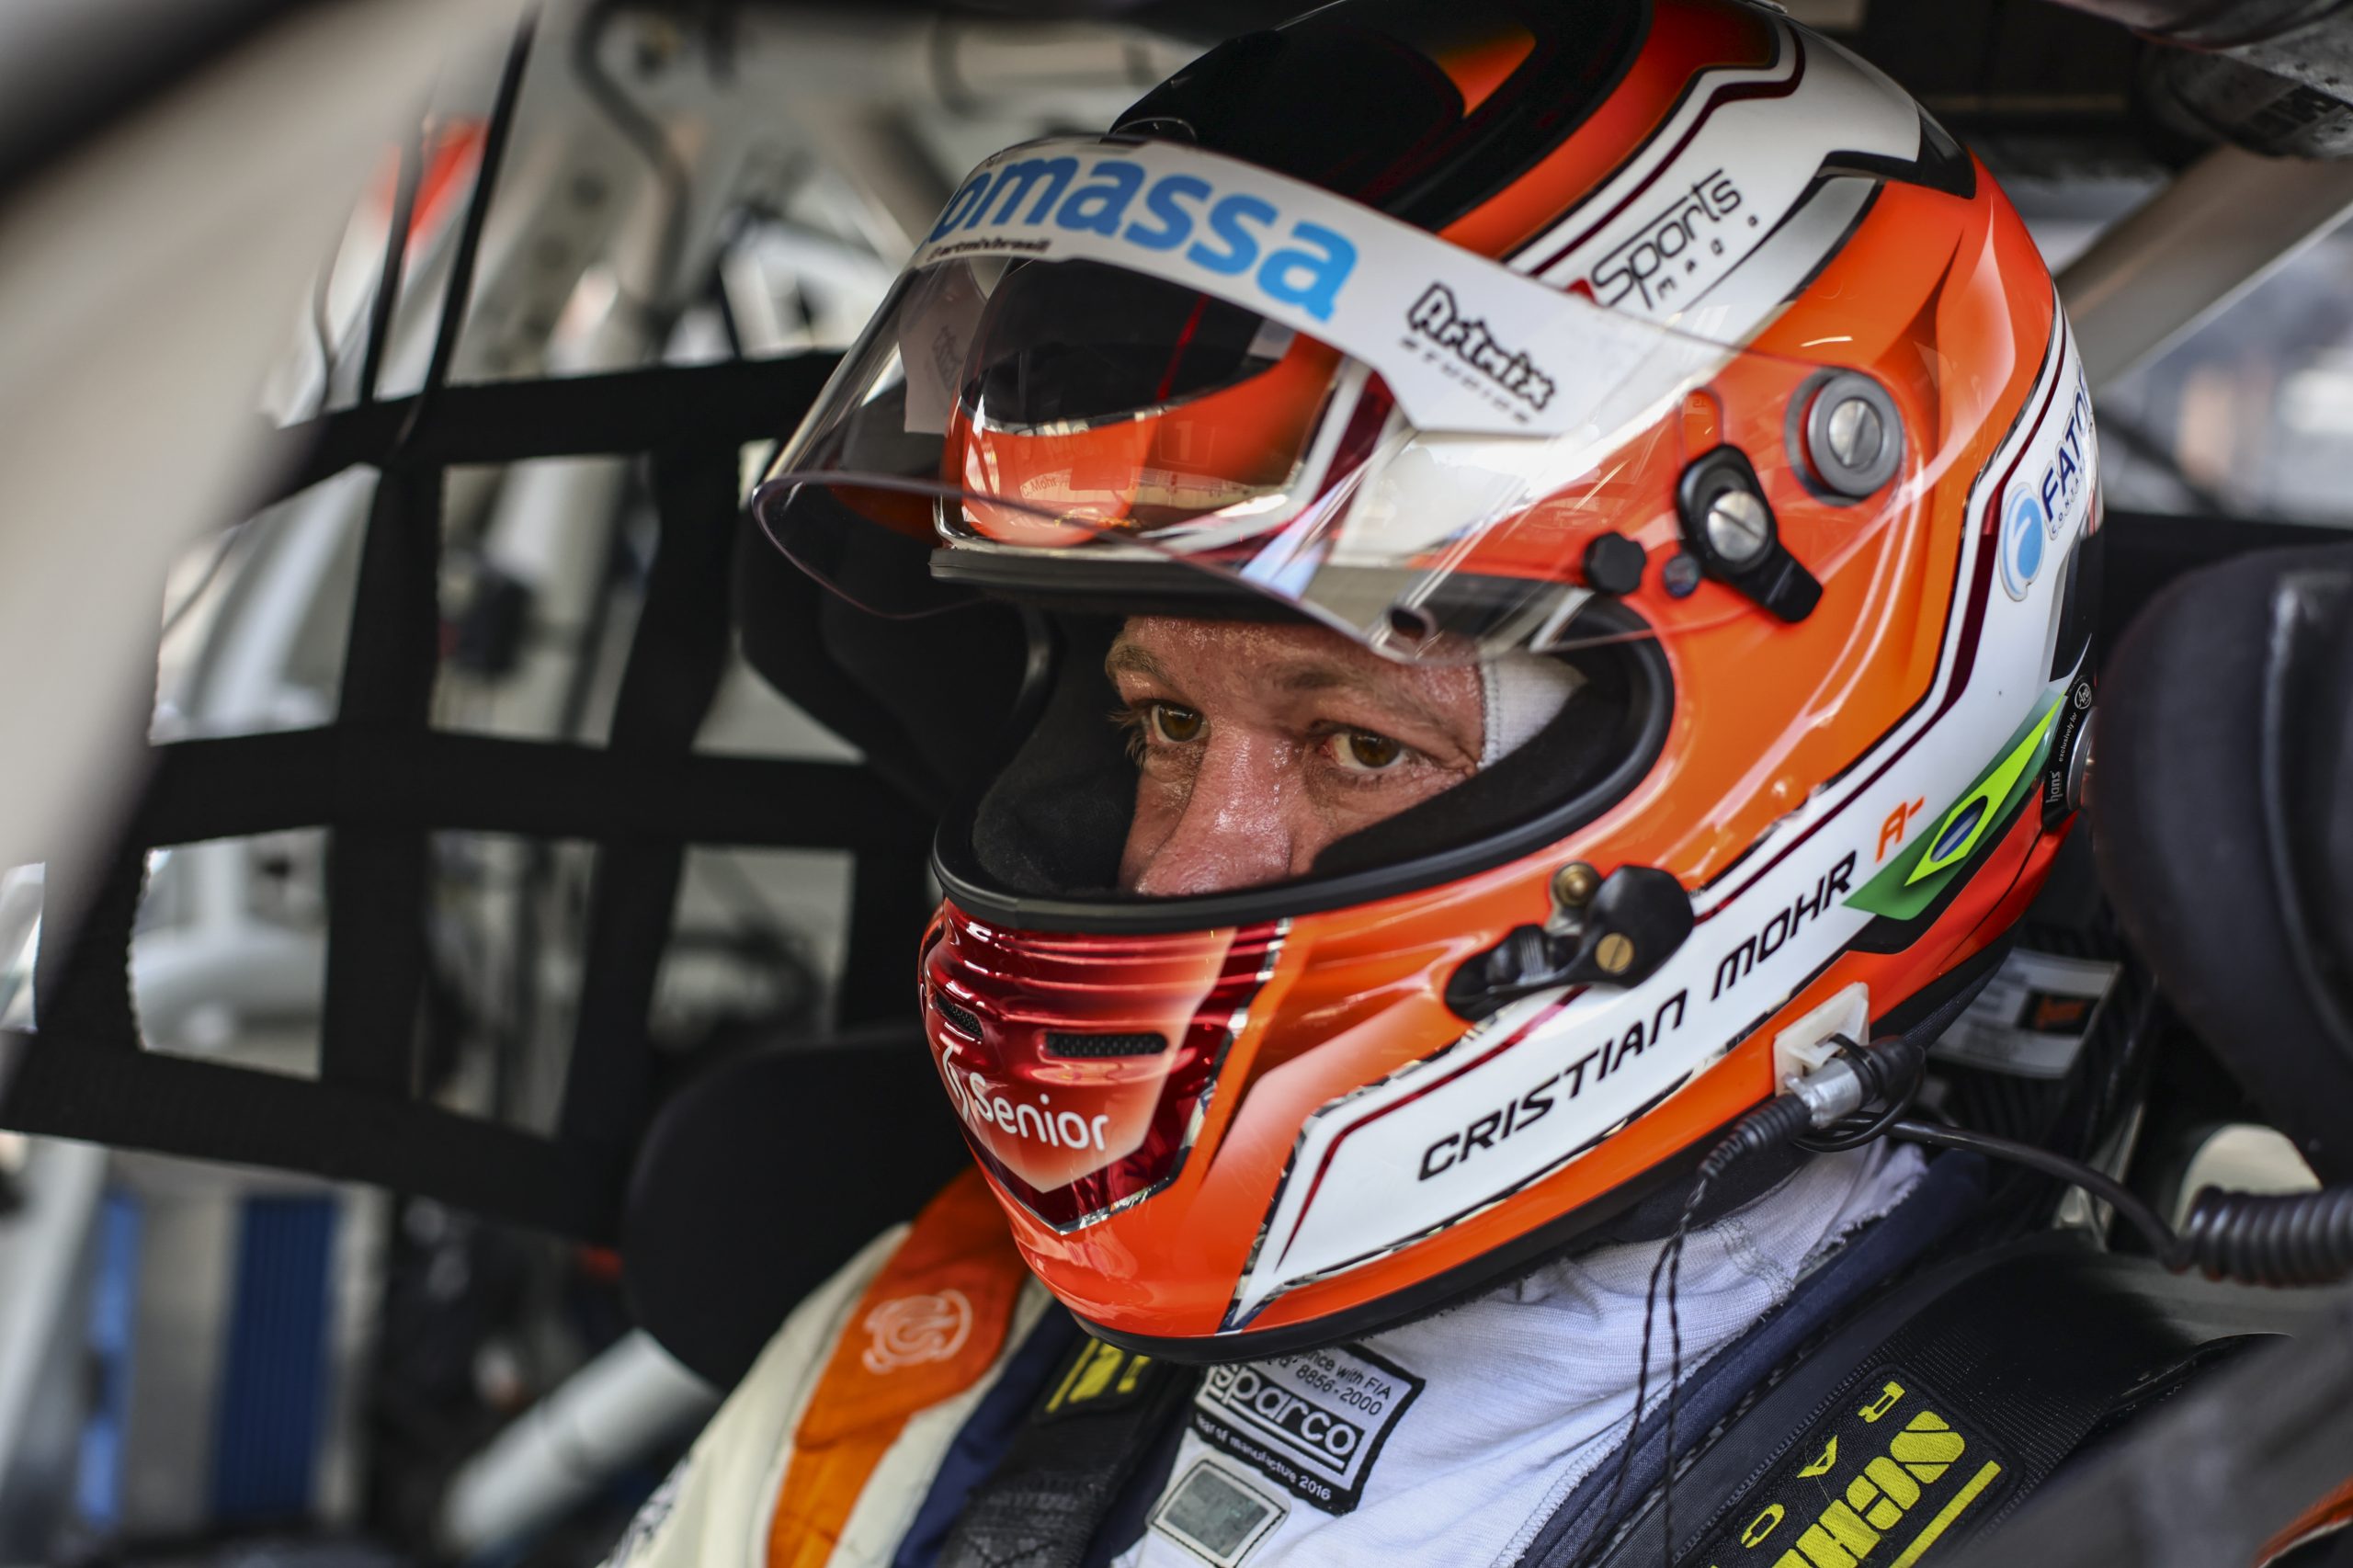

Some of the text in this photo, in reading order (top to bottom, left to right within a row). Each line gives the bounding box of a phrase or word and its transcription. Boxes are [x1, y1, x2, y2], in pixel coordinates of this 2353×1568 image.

[1417, 988, 1689, 1181] CRISTIAN
[1711, 850, 1858, 1002] MOHR
[1336, 1362, 1364, 1385] with
[1364, 1376, 1392, 1400] FIA
[1298, 1474, 1331, 1501] 2016
[1710, 1381, 1904, 1568] RAC
